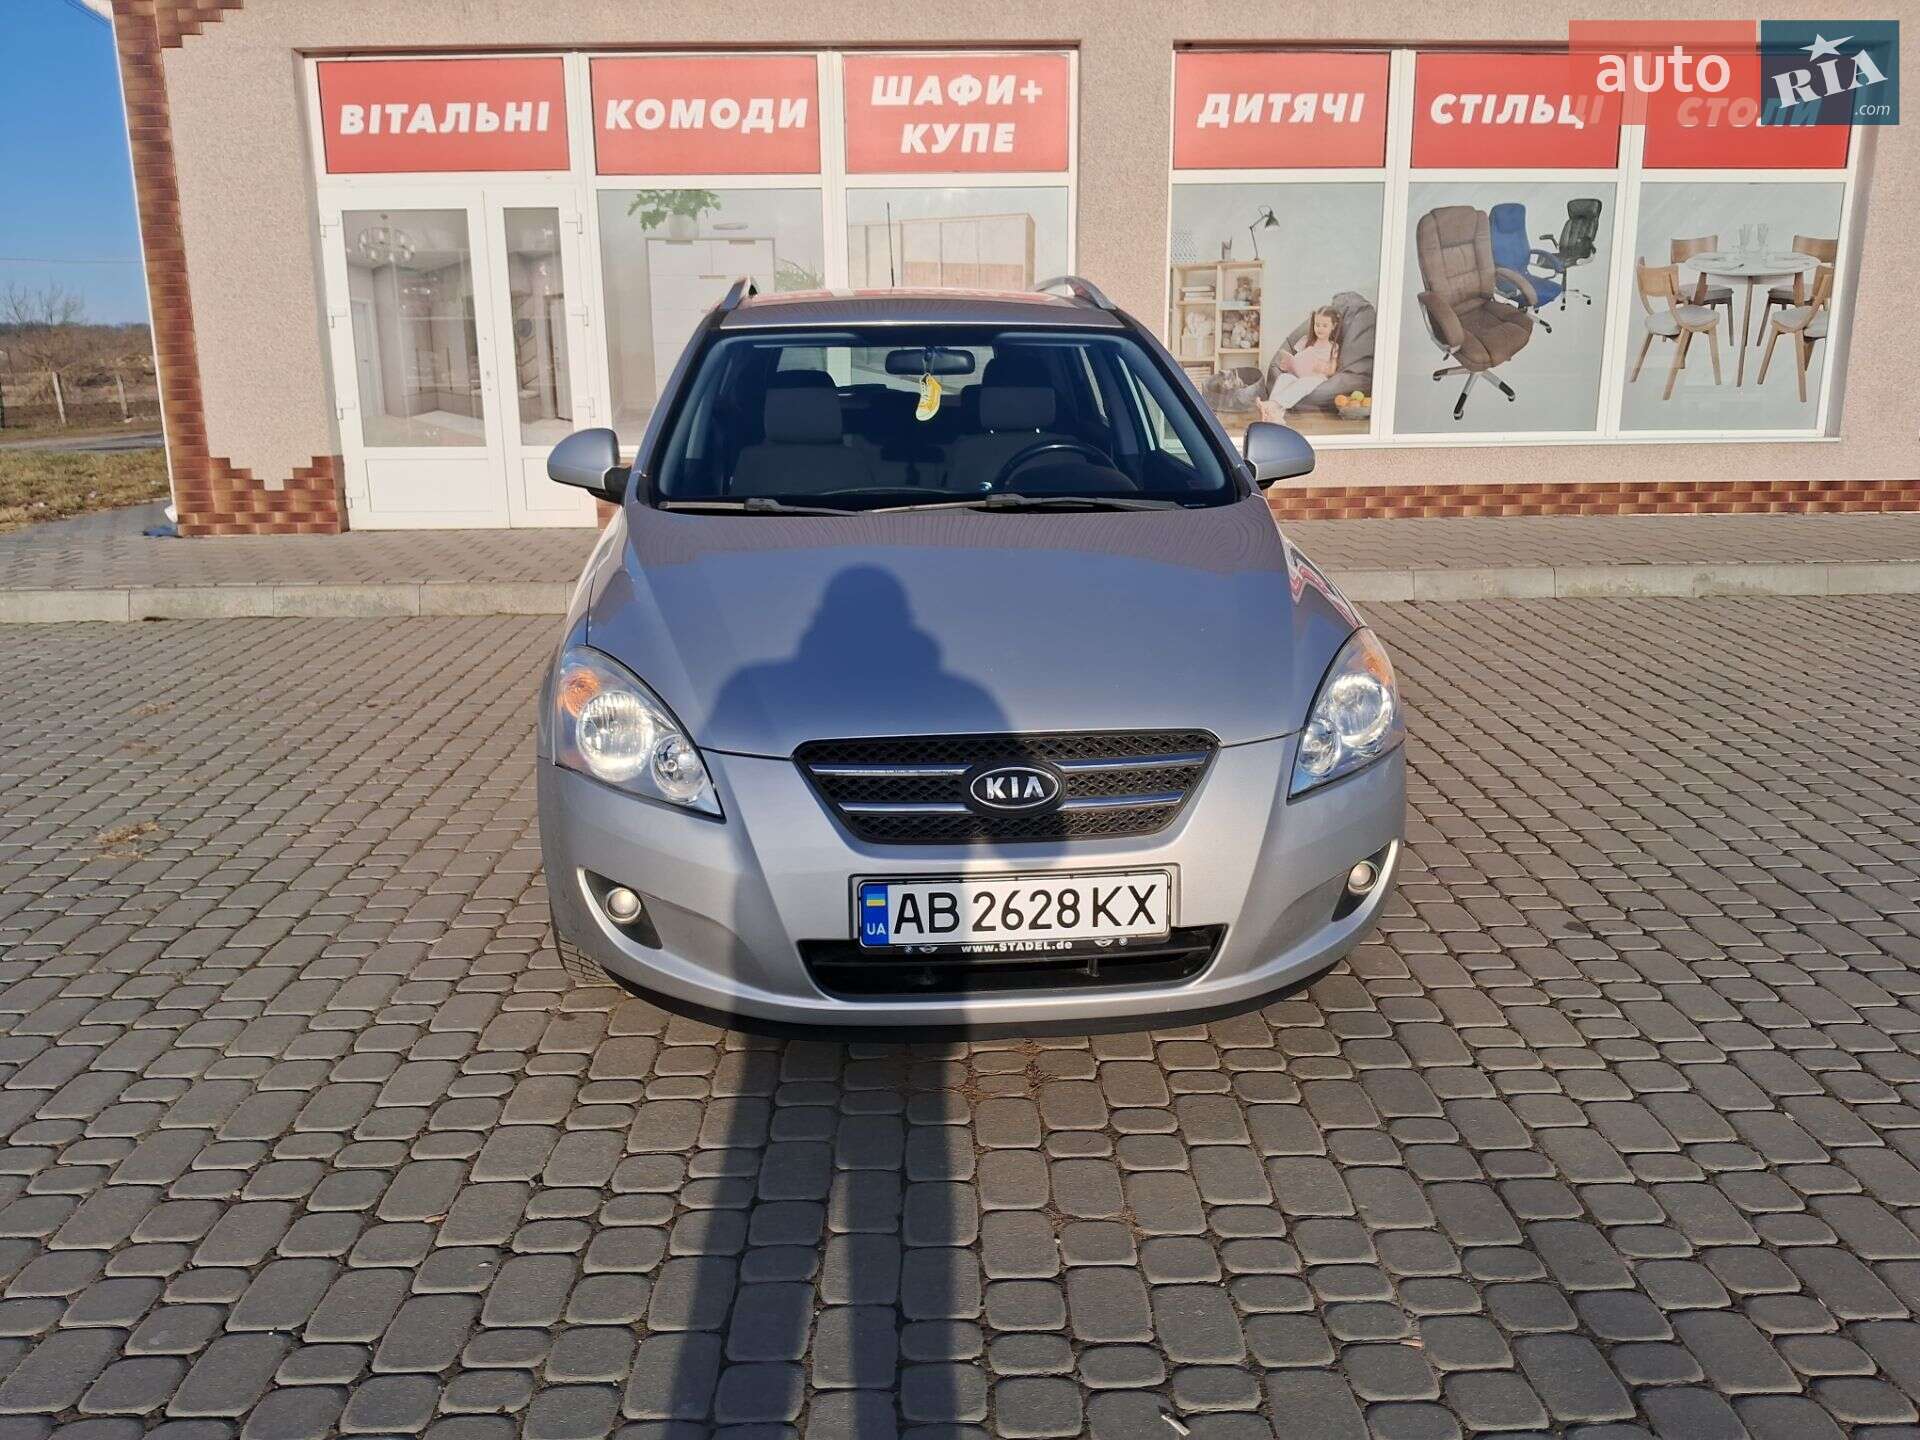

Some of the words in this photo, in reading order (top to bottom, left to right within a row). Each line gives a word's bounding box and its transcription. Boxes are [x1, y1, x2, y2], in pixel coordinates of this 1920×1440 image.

[870, 74, 1044, 107] ШАФИ+
[338, 101, 551, 136] ВІТАЛЬНІ
[604, 97, 810, 135] КОМОДИ
[1196, 92, 1365, 129] ДИТЯЧІ
[900, 122, 1016, 154] КУПЕ
[985, 775, 1046, 801] KIA
[893, 891, 960, 934] AB
[972, 888, 1081, 932] 2628
[1092, 884, 1158, 928] KX
[866, 922, 887, 936] UA
[961, 940, 1073, 953] www.STADEL.de
